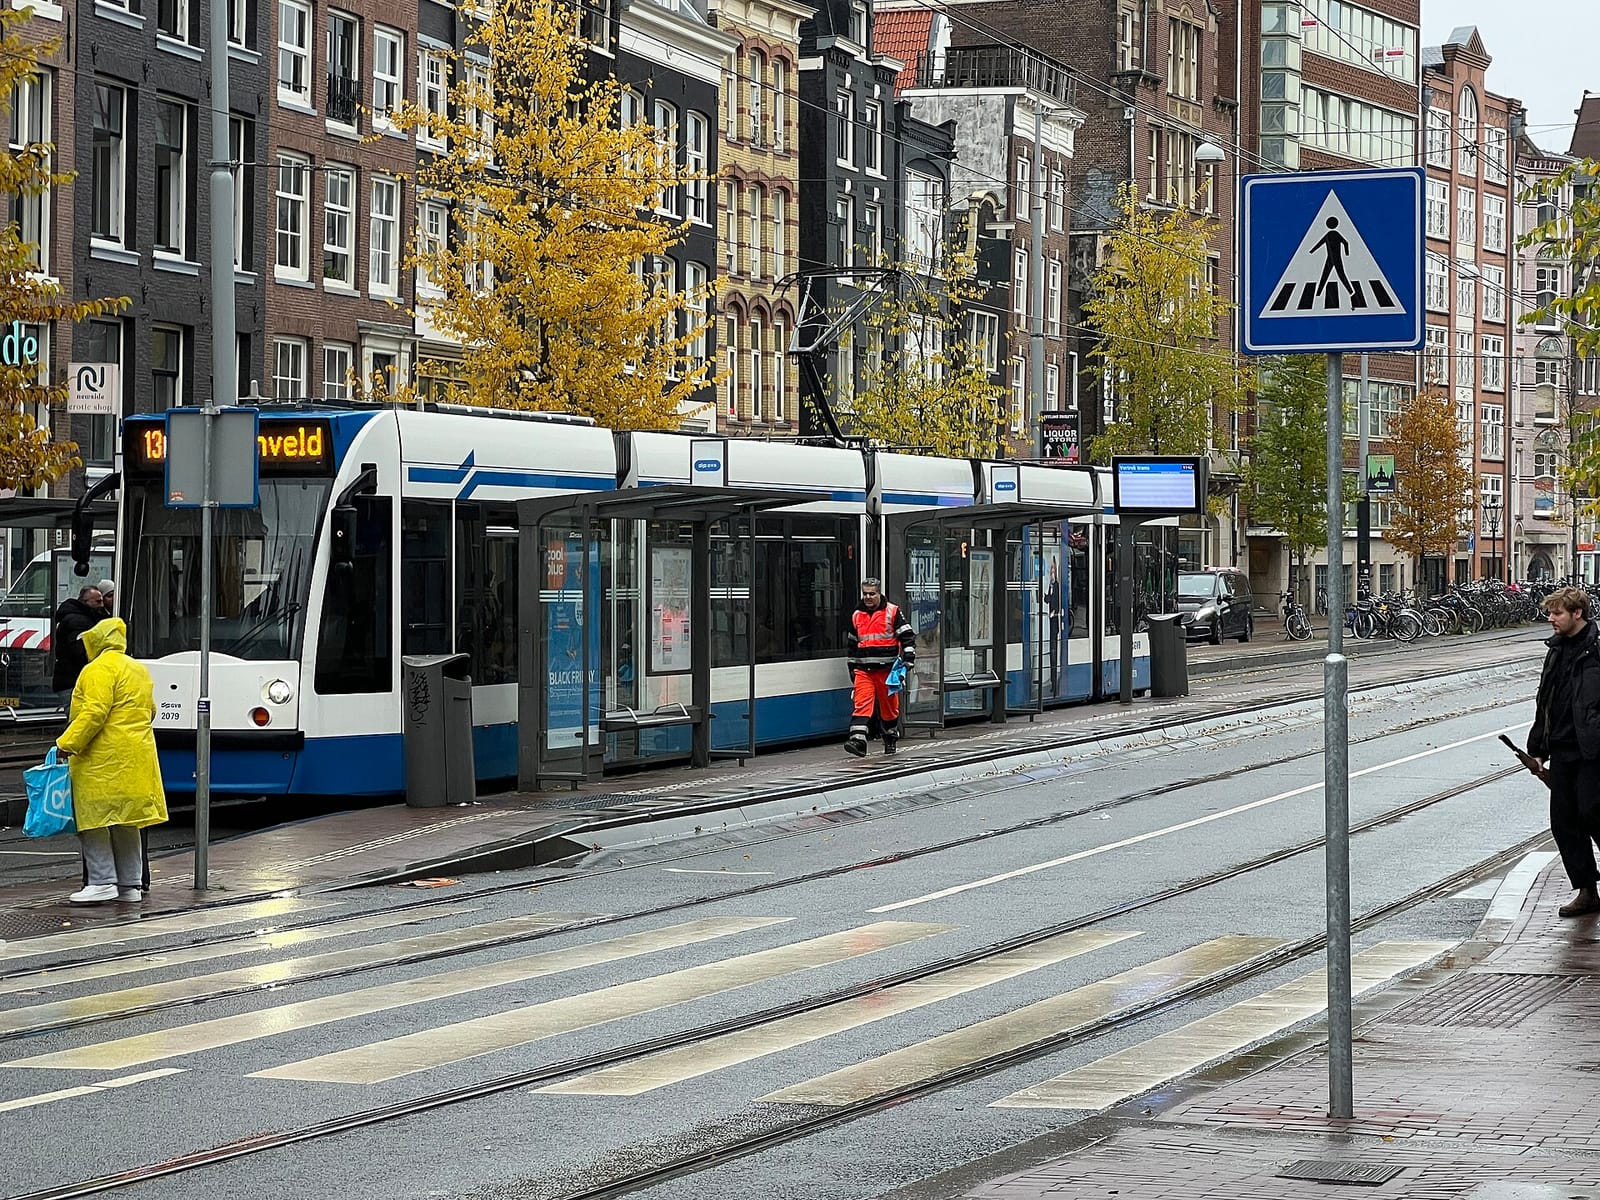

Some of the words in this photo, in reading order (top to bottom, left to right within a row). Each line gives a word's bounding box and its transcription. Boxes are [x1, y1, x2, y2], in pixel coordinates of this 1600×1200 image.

[68, 403, 92, 411] erotic
[93, 403, 112, 412] shop
[1043, 430, 1077, 438] LIQUOR
[144, 429, 162, 459] 13
[257, 427, 322, 457] nveld
[910, 557, 940, 583] TRUE
[549, 671, 571, 685] BLACK
[161, 712, 180, 720] 2079
